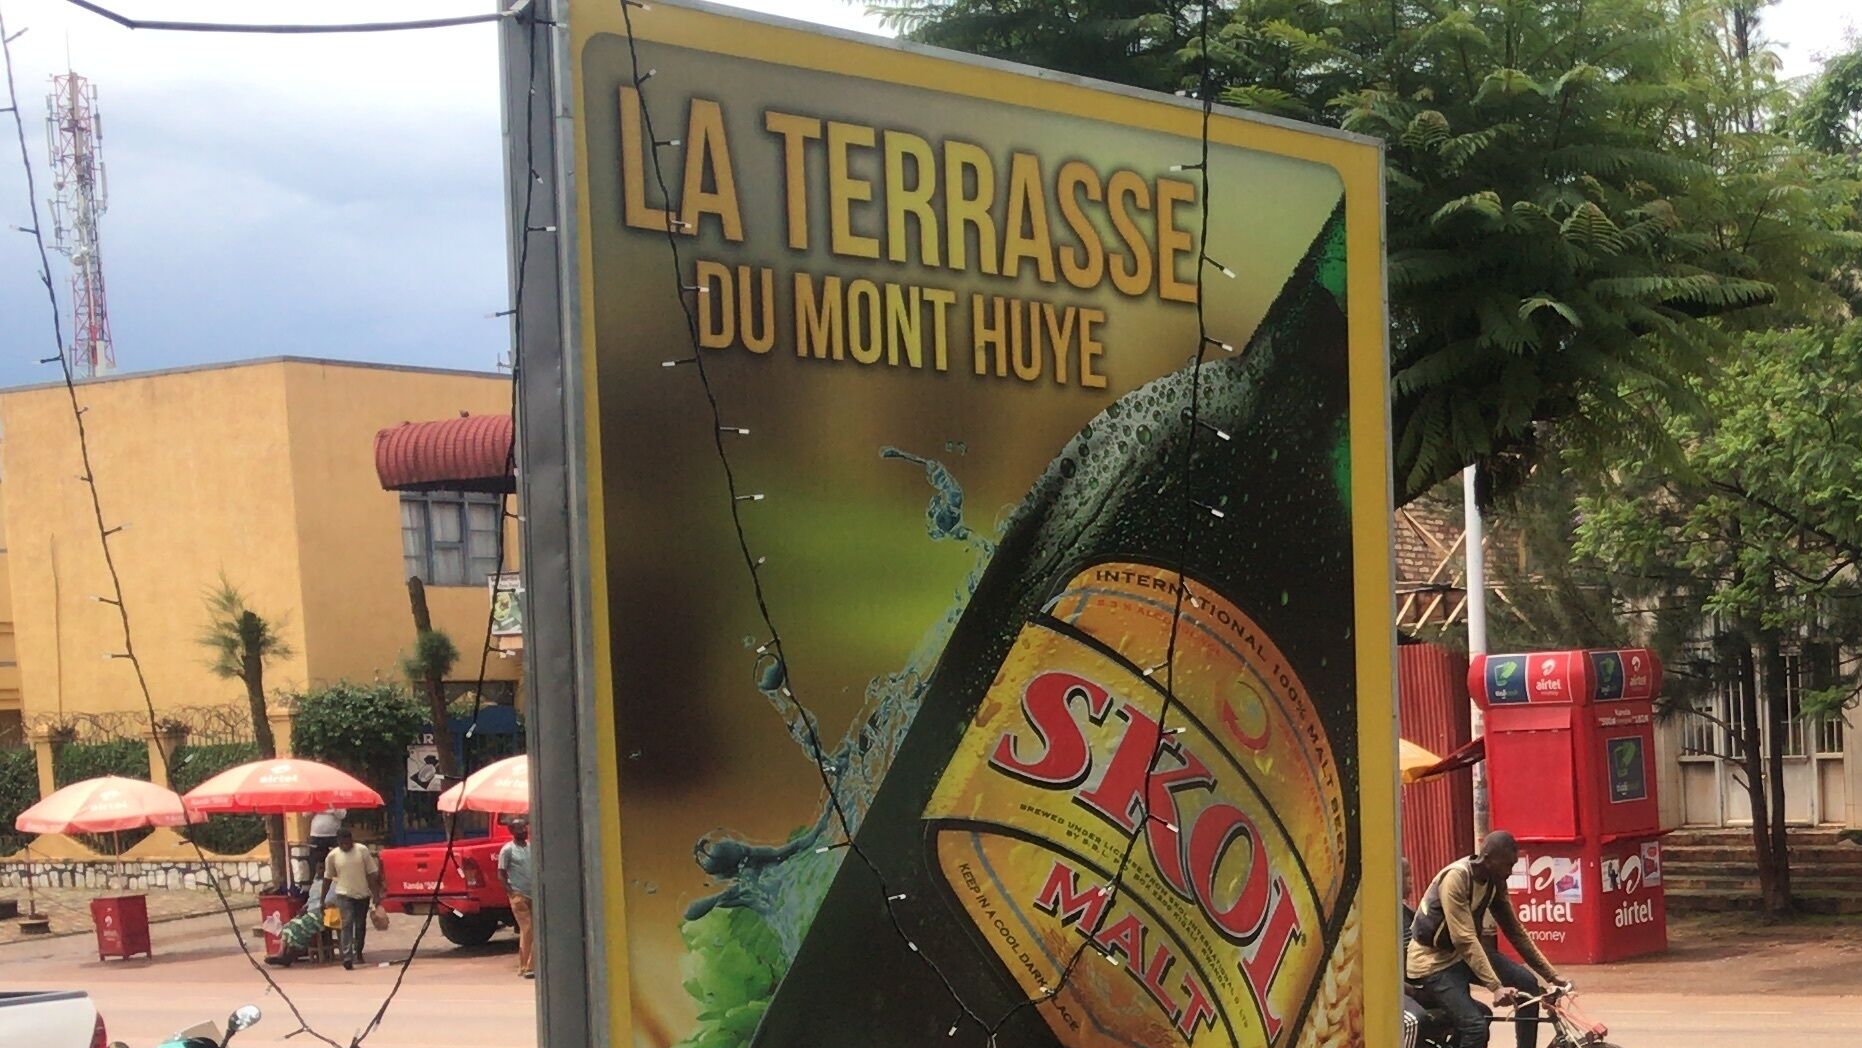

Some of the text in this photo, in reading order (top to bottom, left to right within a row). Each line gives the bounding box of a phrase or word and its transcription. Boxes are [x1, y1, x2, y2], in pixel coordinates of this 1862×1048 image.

[619, 86, 1199, 304] LA TERRASSE
[697, 260, 1108, 388] DU MONT HUYE
[1535, 678, 1563, 691] airtel
[1273, 664, 1306, 720] 100%
[1307, 724, 1334, 787] MALT
[259, 774, 299, 784] airtel
[1020, 803, 1065, 825] BREWED
[1067, 821, 1102, 843] UNDER
[1145, 873, 1168, 897] FROM
[1066, 829, 1080, 840] BY
[1133, 874, 1151, 890] BOX
[958, 862, 1080, 1032] KEEP IN A COOL DARK LACE
[1518, 897, 1574, 923] airtel
[1528, 930, 1566, 943] money
[1615, 898, 1654, 928] airtel
[1033, 860, 1219, 1047] MALT
